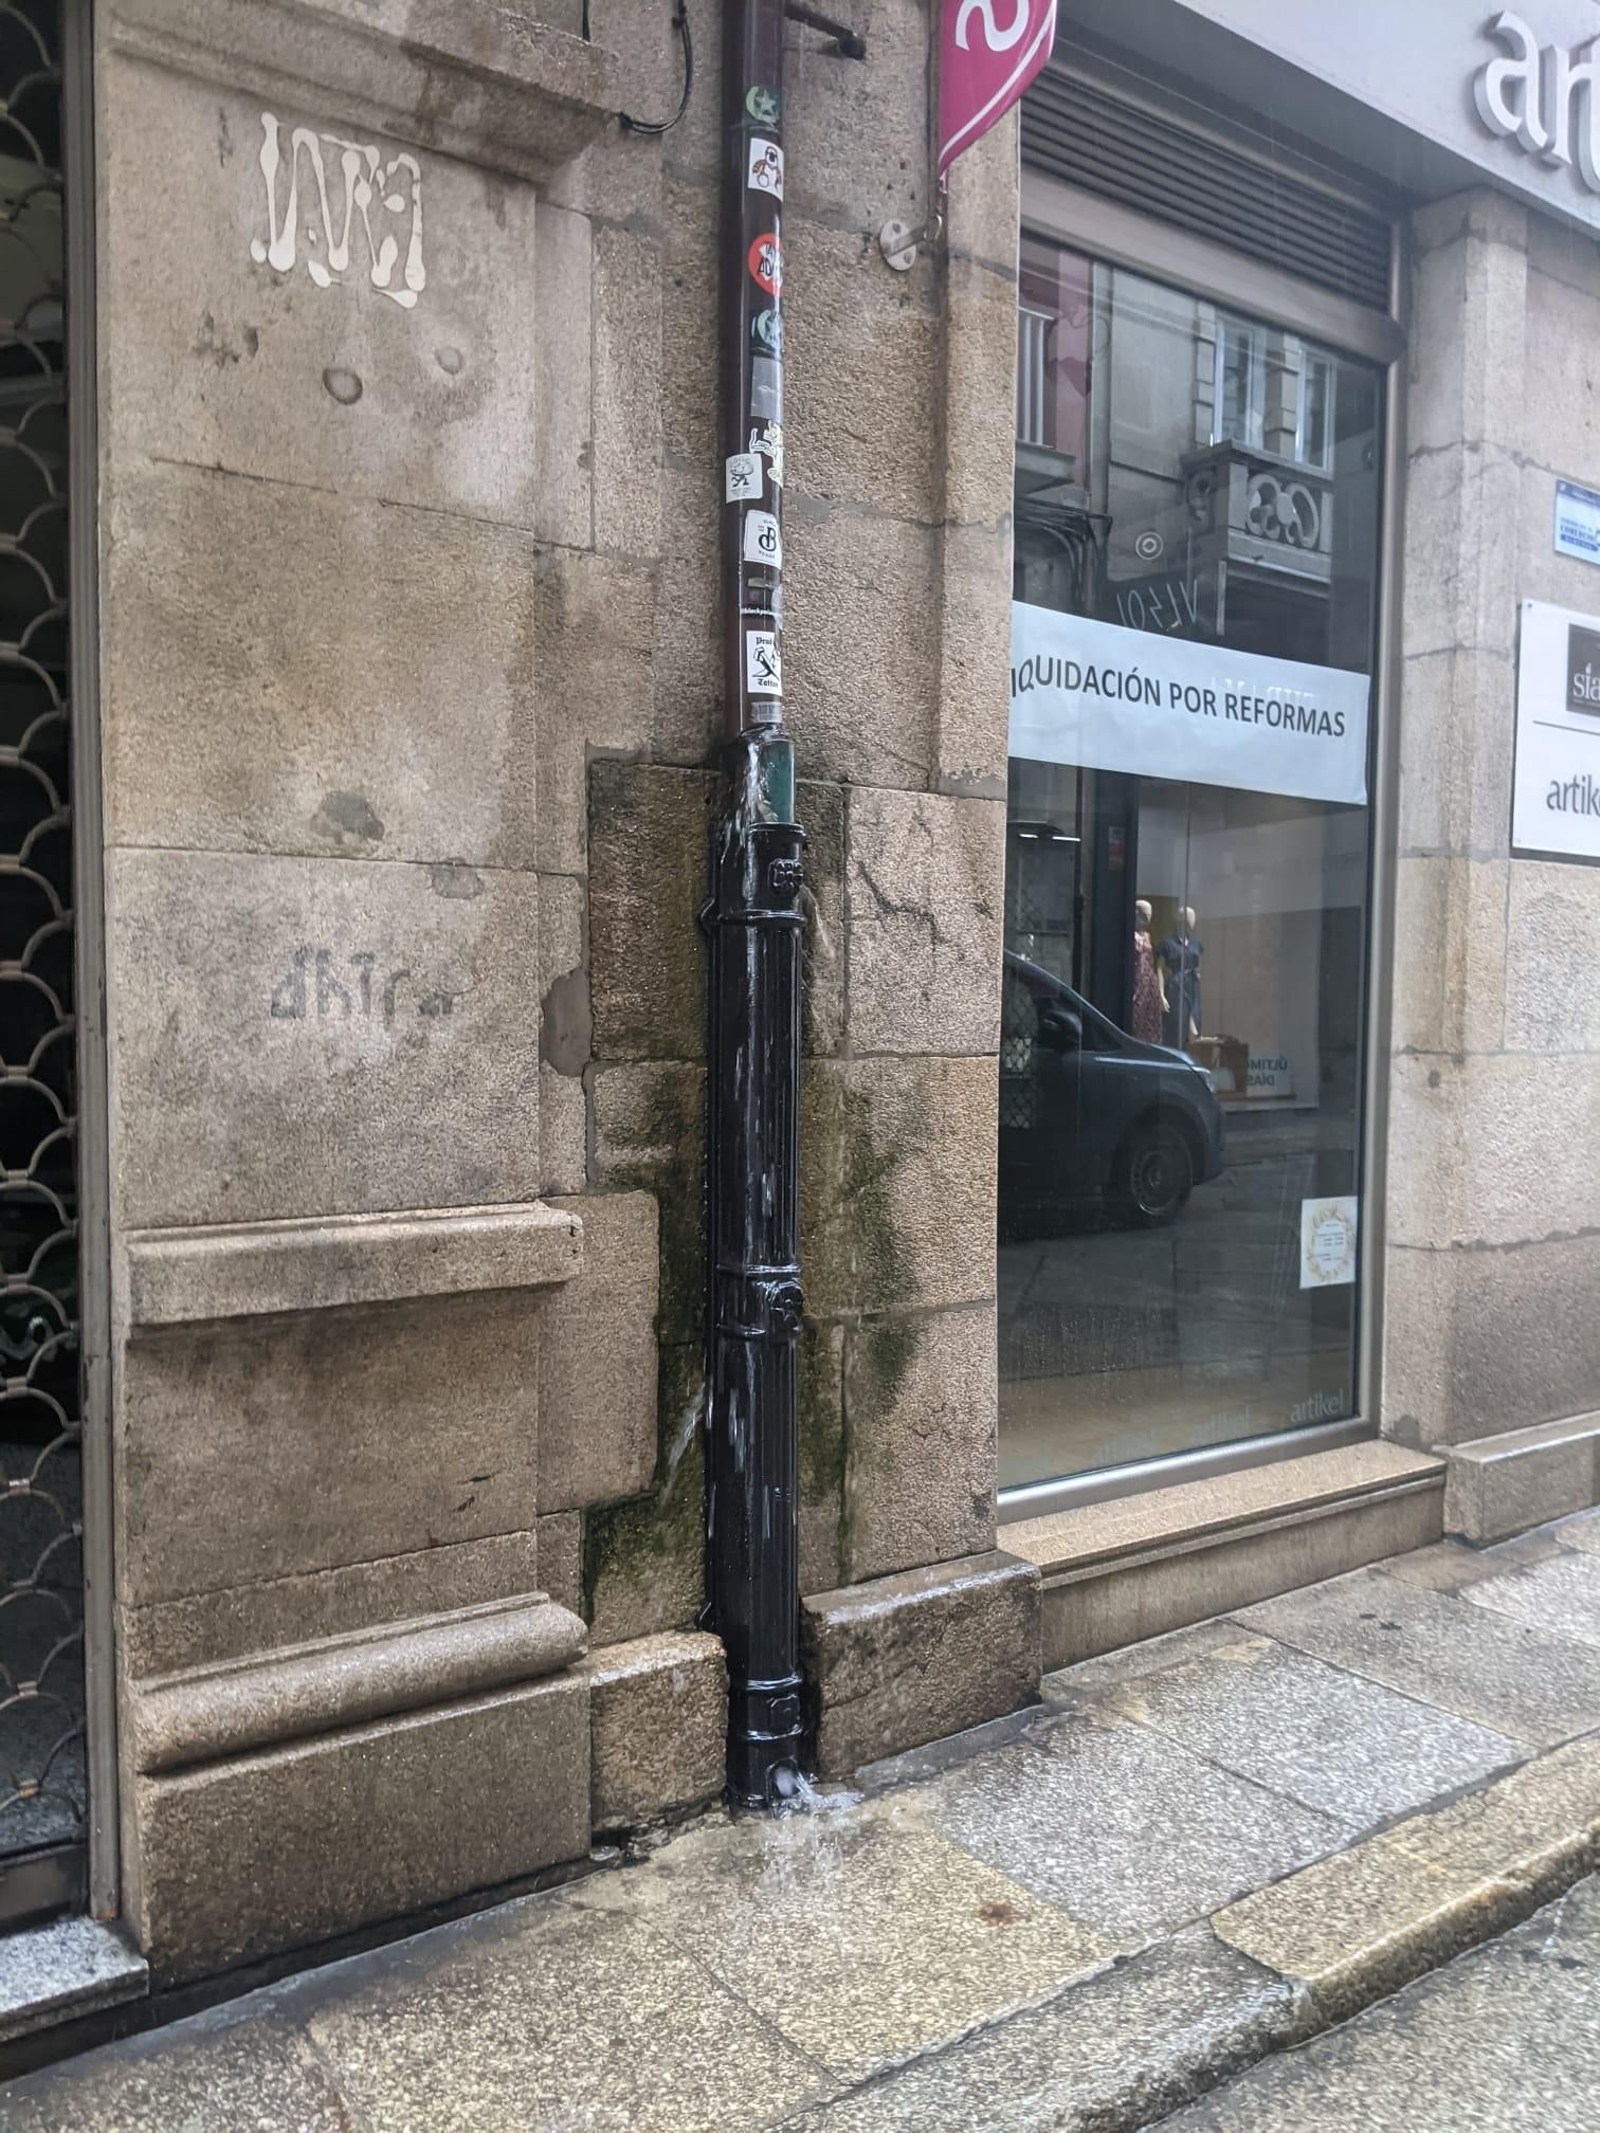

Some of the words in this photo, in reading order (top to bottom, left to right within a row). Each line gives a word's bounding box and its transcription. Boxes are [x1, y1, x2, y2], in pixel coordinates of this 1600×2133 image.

[1011, 654, 1161, 707] IQUIDACIÓN
[1169, 682, 1217, 718] POR
[1224, 692, 1346, 738] REFORMAS
[1546, 774, 1600, 818] artik
